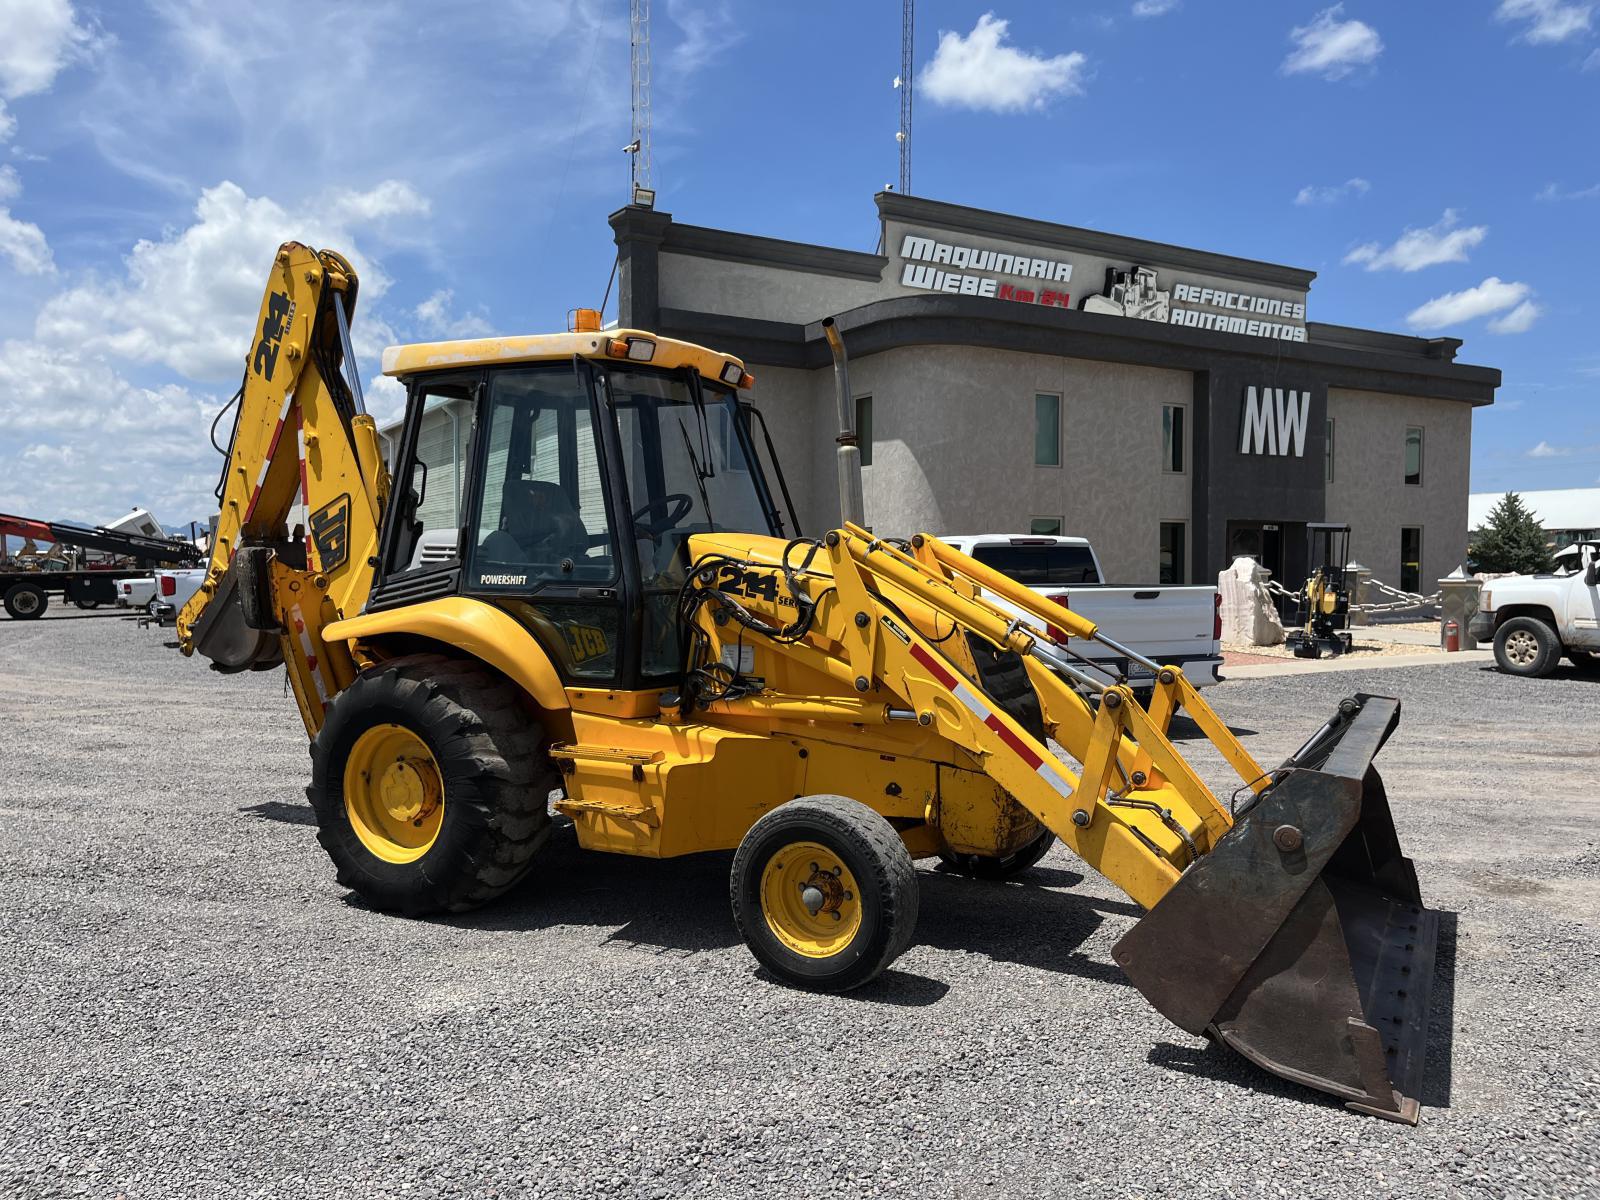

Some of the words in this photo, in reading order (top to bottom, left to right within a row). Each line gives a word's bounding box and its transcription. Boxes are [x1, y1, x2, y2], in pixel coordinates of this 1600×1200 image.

[901, 236, 1072, 282] MAQUINARIA
[902, 264, 997, 298] WIEBE
[1174, 284, 1305, 319] REFACCIONES
[1171, 308, 1305, 342] ADITAMENTOS
[1241, 385, 1311, 457] MW
[313, 504, 347, 571] JCB
[480, 574, 527, 585] POWERSHIFT
[719, 567, 777, 602] 214
[778, 596, 798, 609] SER
[569, 625, 609, 661] JCB
